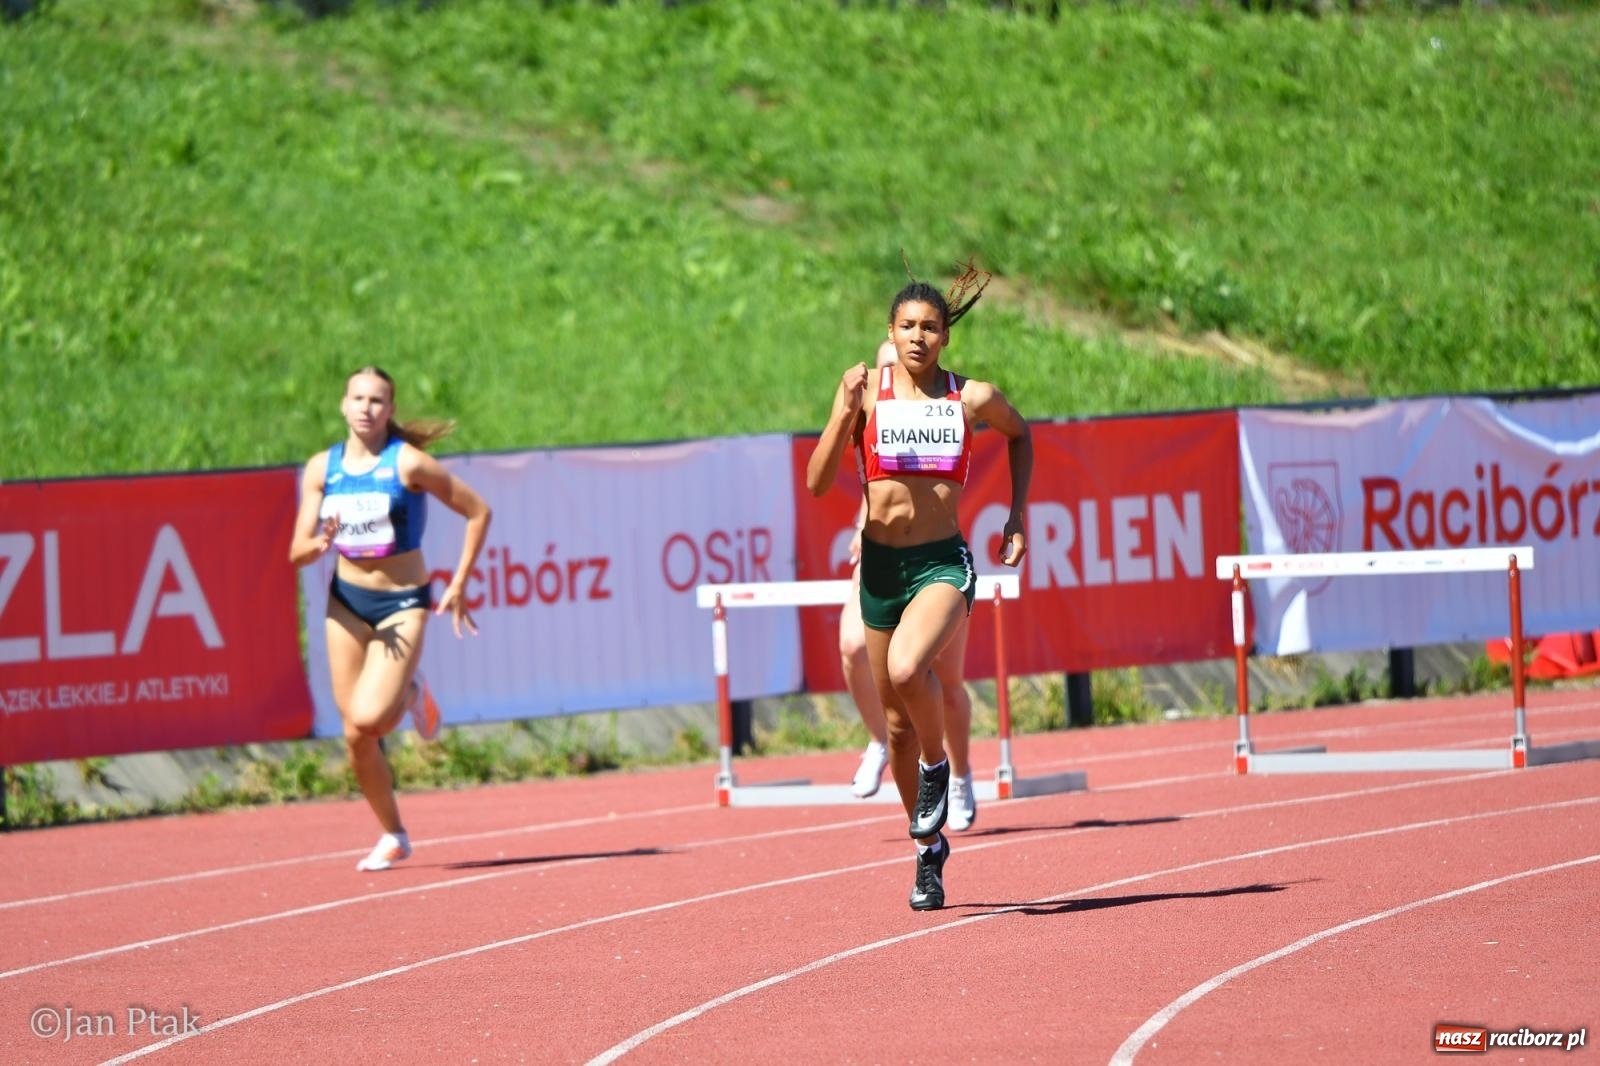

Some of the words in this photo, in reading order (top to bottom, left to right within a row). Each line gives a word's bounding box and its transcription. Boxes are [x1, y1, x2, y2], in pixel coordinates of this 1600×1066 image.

[925, 404, 955, 417] 216
[881, 428, 960, 444] EMANUEL
[1361, 461, 1600, 551] Racibór
[661, 527, 773, 592] OSiR
[46, 681, 130, 709] LEKKIEJ
[135, 673, 229, 702] ATLETYKI
